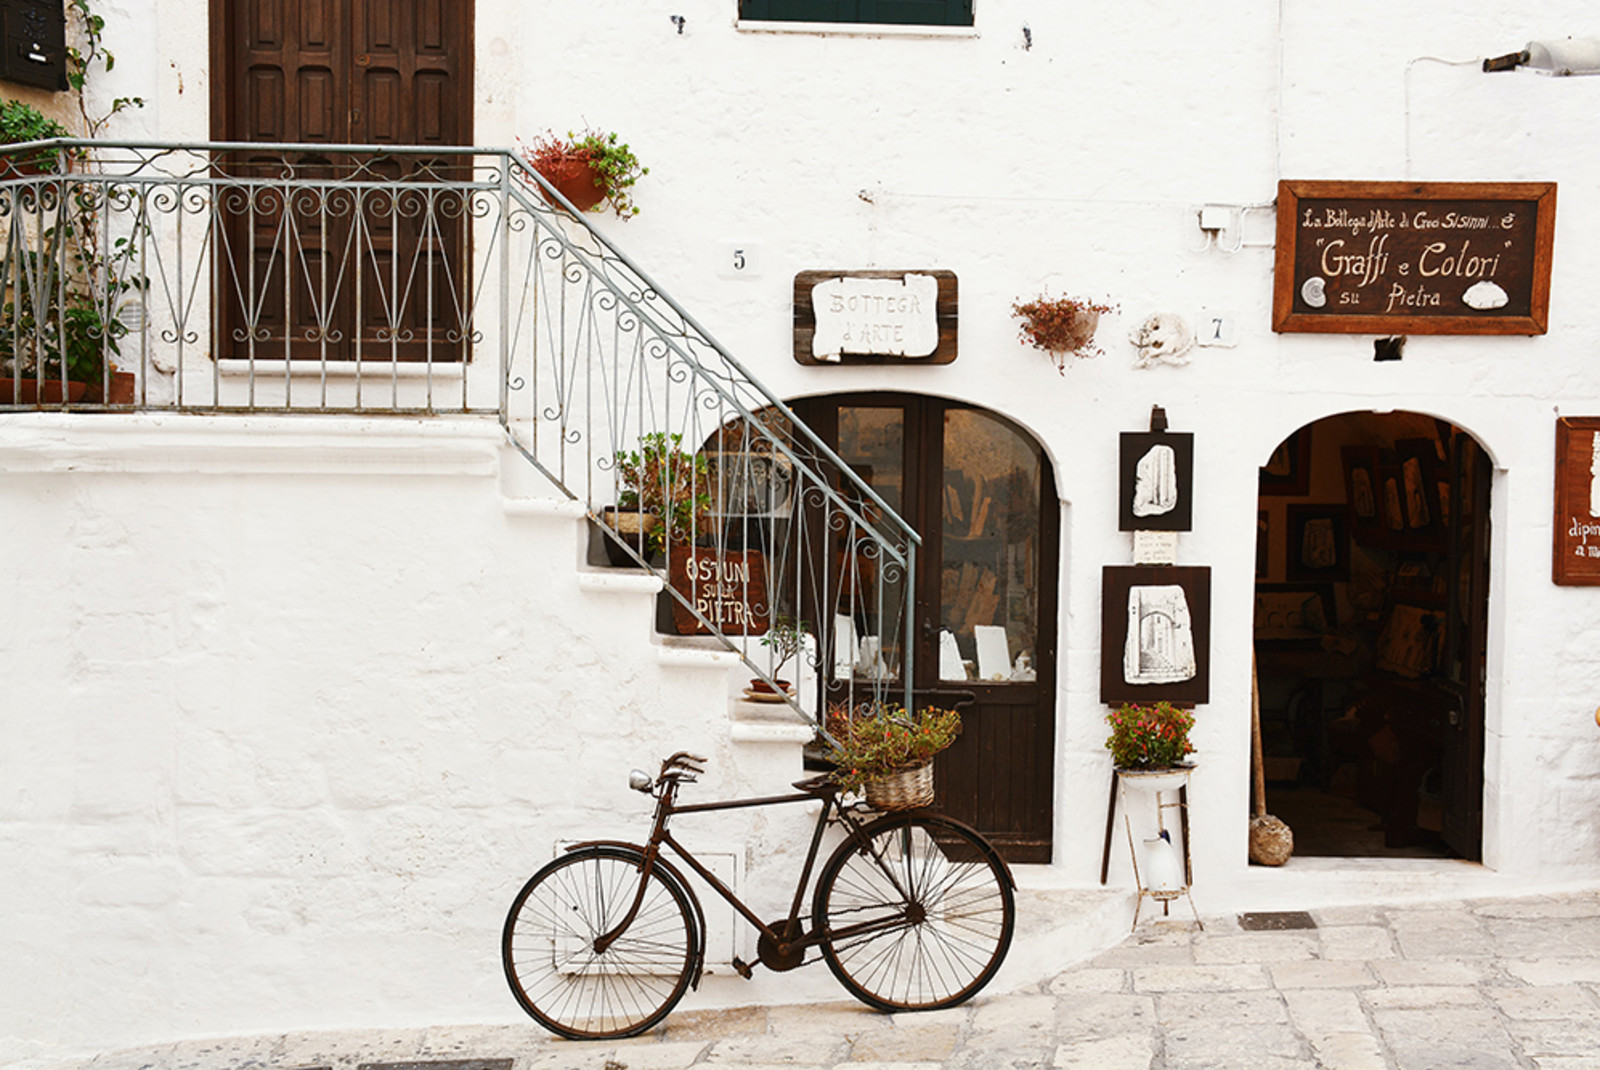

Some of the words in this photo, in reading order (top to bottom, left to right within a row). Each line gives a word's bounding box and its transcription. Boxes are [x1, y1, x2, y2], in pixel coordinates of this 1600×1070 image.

[1302, 208, 1321, 227] La
[1324, 208, 1366, 236] Bottega
[733, 249, 746, 271] 5
[1398, 262, 1410, 276] e
[829, 293, 922, 315] BOTTEGA
[1339, 291, 1360, 305] su
[1386, 282, 1441, 313] Pietra
[1212, 318, 1222, 340] 7
[1575, 545, 1585, 557] a
[697, 598, 757, 629] PIETRA
